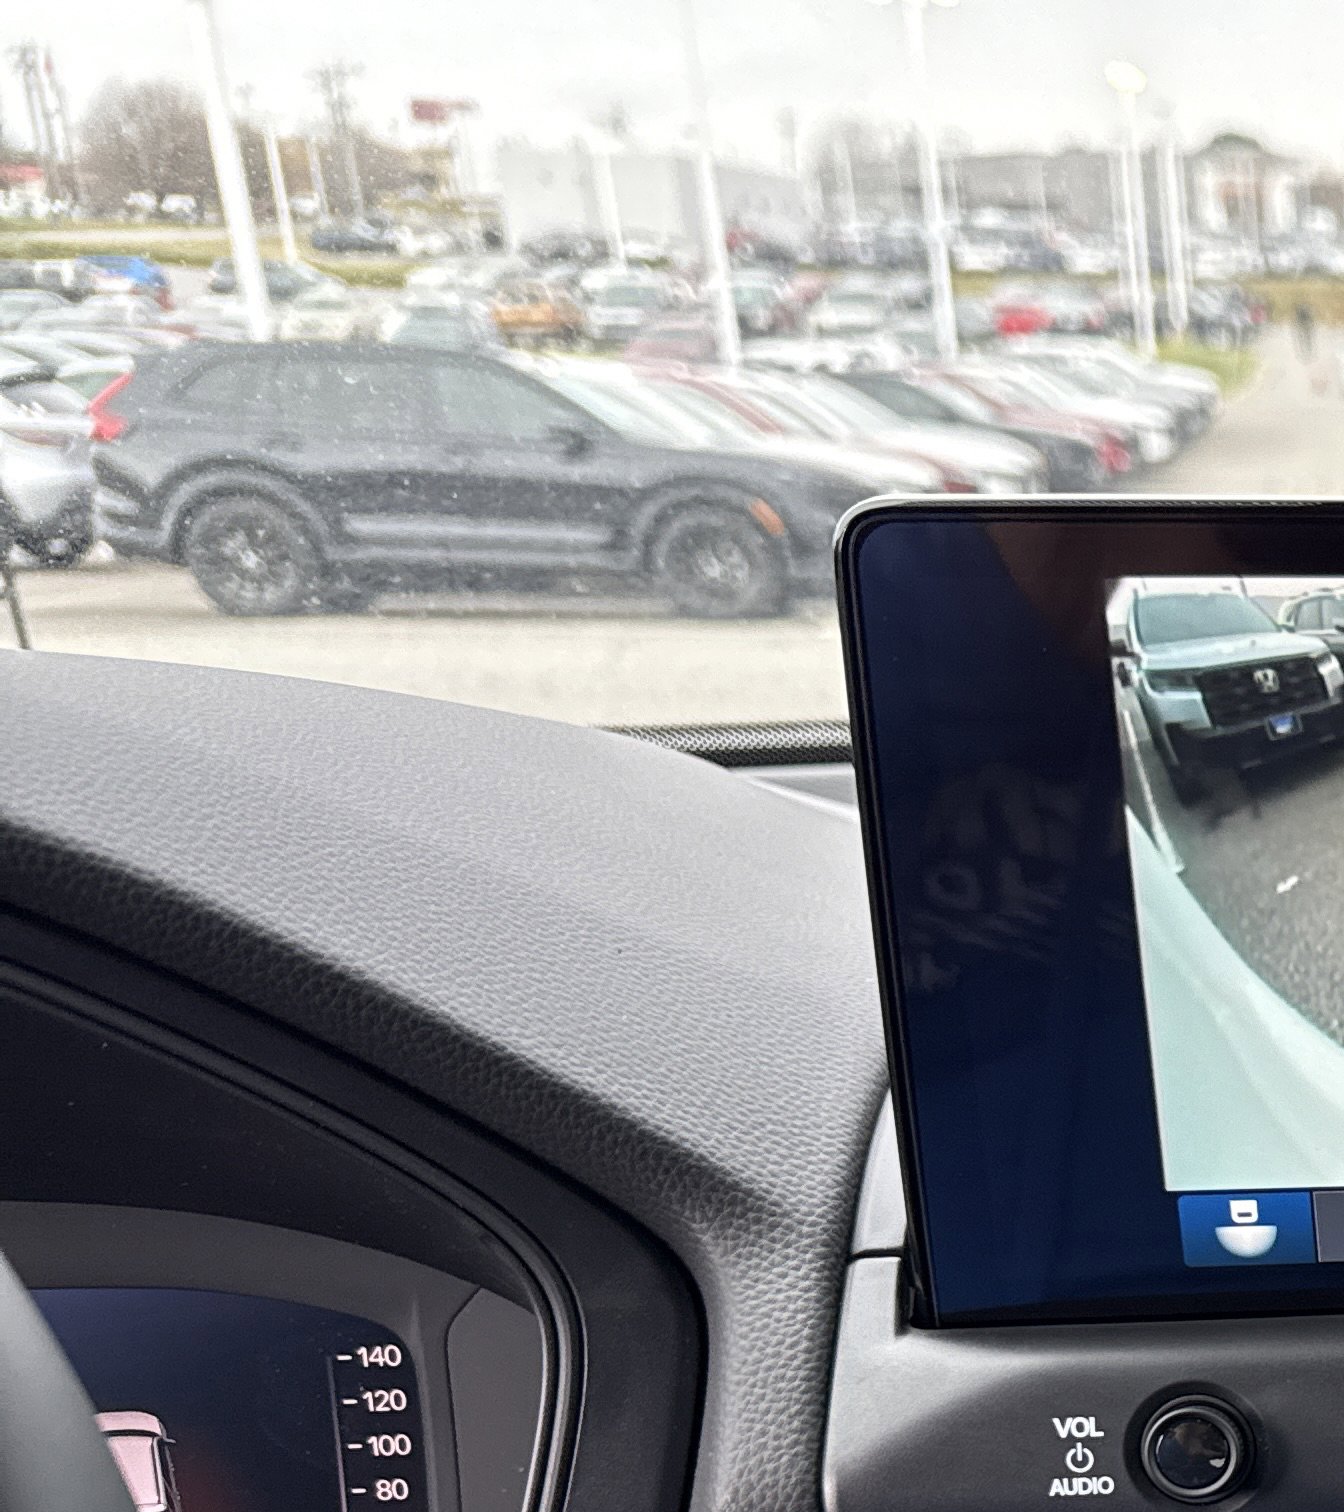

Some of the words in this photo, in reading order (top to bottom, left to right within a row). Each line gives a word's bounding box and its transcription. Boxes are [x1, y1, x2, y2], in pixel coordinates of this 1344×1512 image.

[356, 1344, 402, 1368] 140
[362, 1388, 407, 1412] 120
[1051, 1416, 1105, 1439] VOL
[367, 1433, 412, 1457] 100
[375, 1478, 409, 1501] 80
[1048, 1475, 1115, 1497] AUDIO
